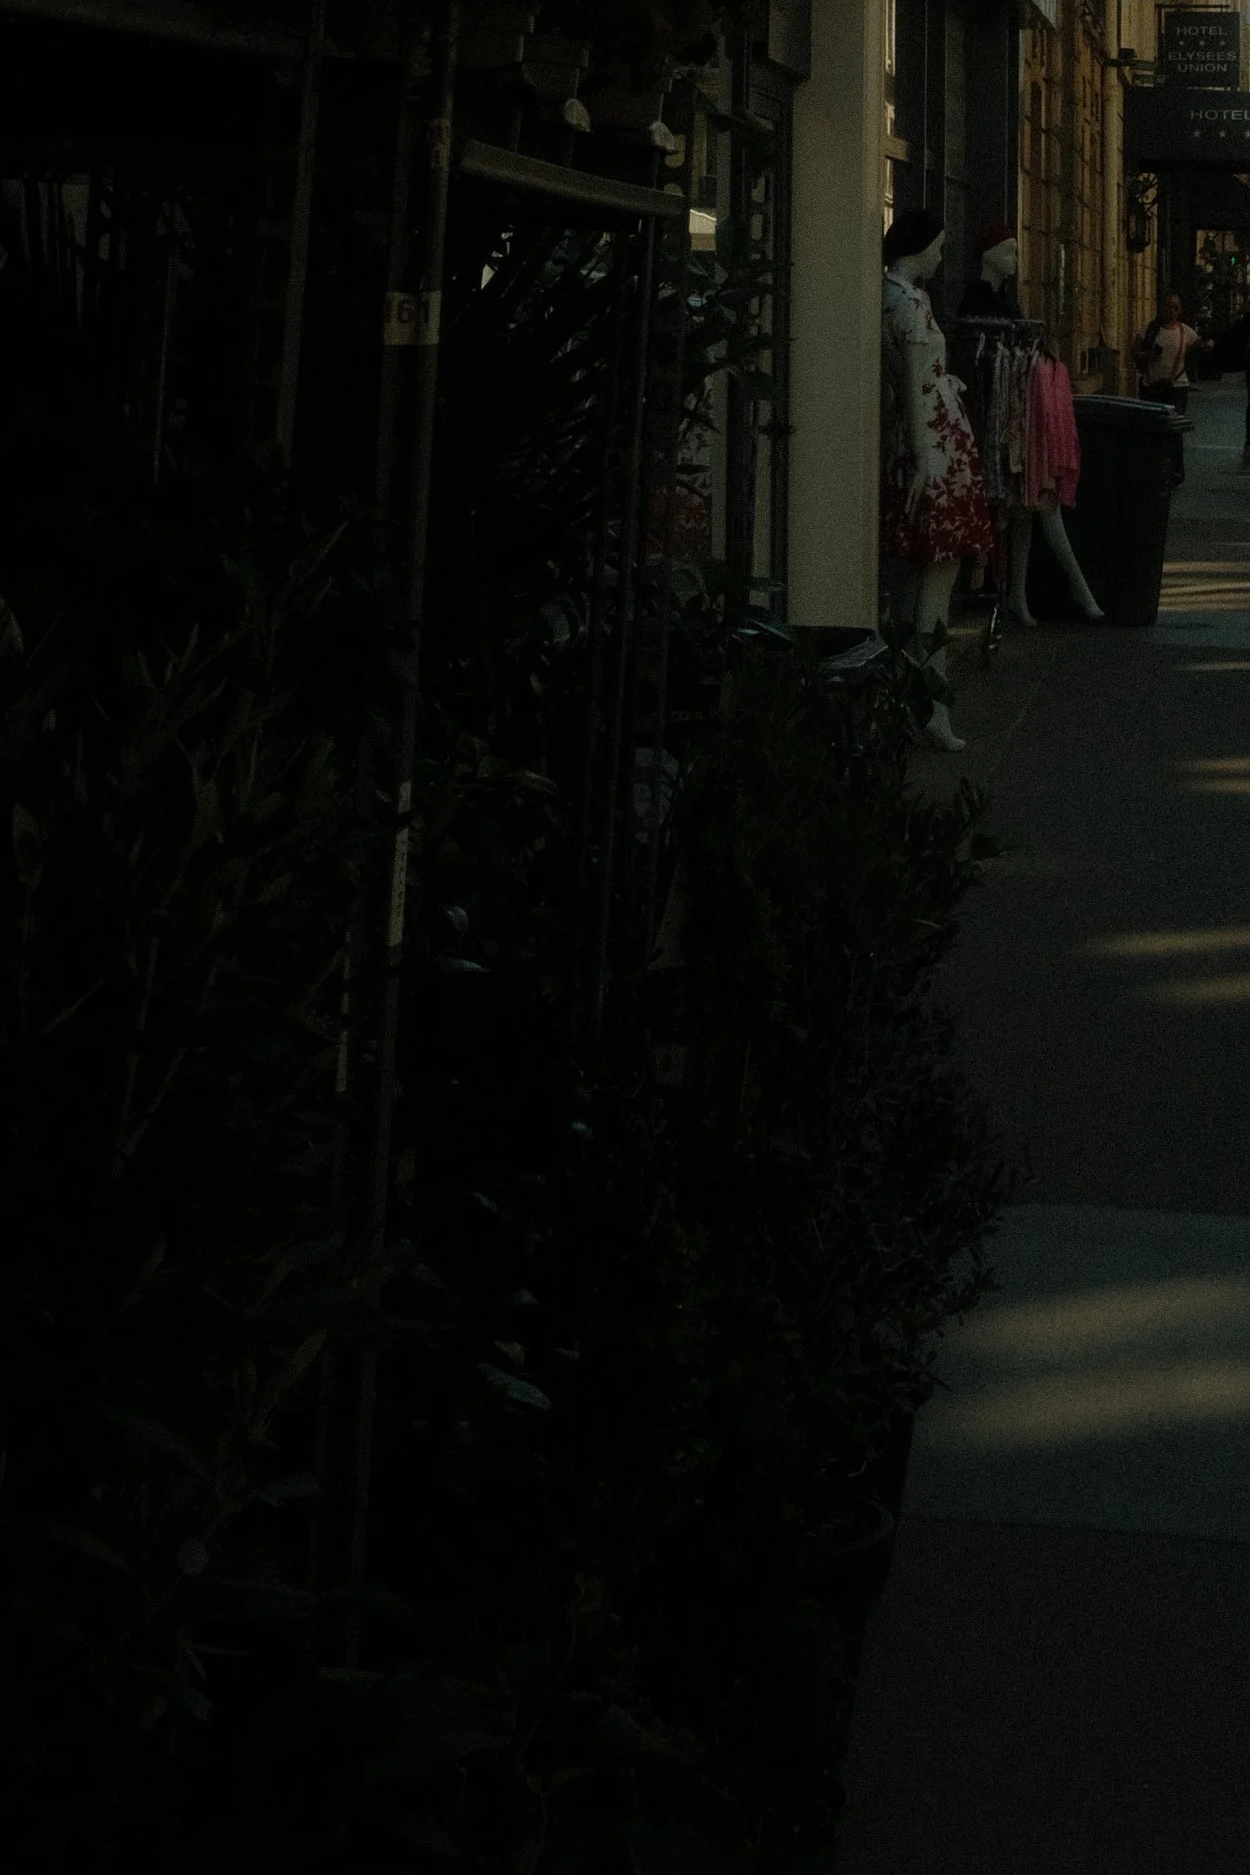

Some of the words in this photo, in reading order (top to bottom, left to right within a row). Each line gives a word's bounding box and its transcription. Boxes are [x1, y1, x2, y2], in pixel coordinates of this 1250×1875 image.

[1176, 26, 1227, 36] HOTEL
[1168, 51, 1236, 61] ELYSEES
[1177, 63, 1227, 73] UNION
